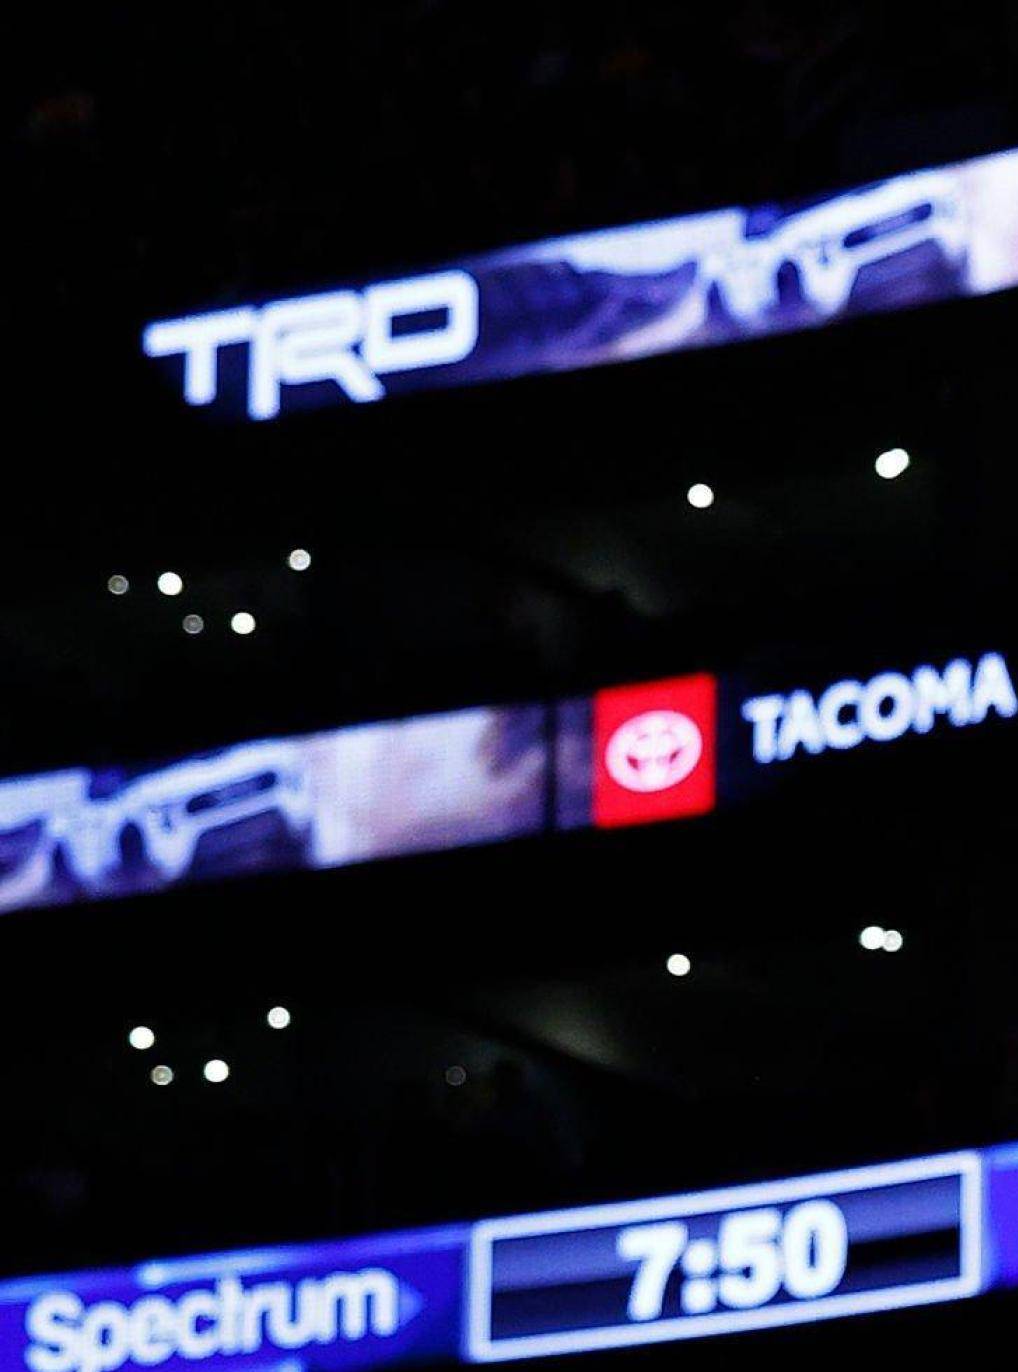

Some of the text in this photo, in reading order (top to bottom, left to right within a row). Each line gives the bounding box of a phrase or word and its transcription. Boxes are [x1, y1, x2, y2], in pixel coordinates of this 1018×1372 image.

[144, 269, 479, 420] TRD
[741, 652, 1018, 764] TACOMA
[616, 1199, 848, 1322] 7:50
